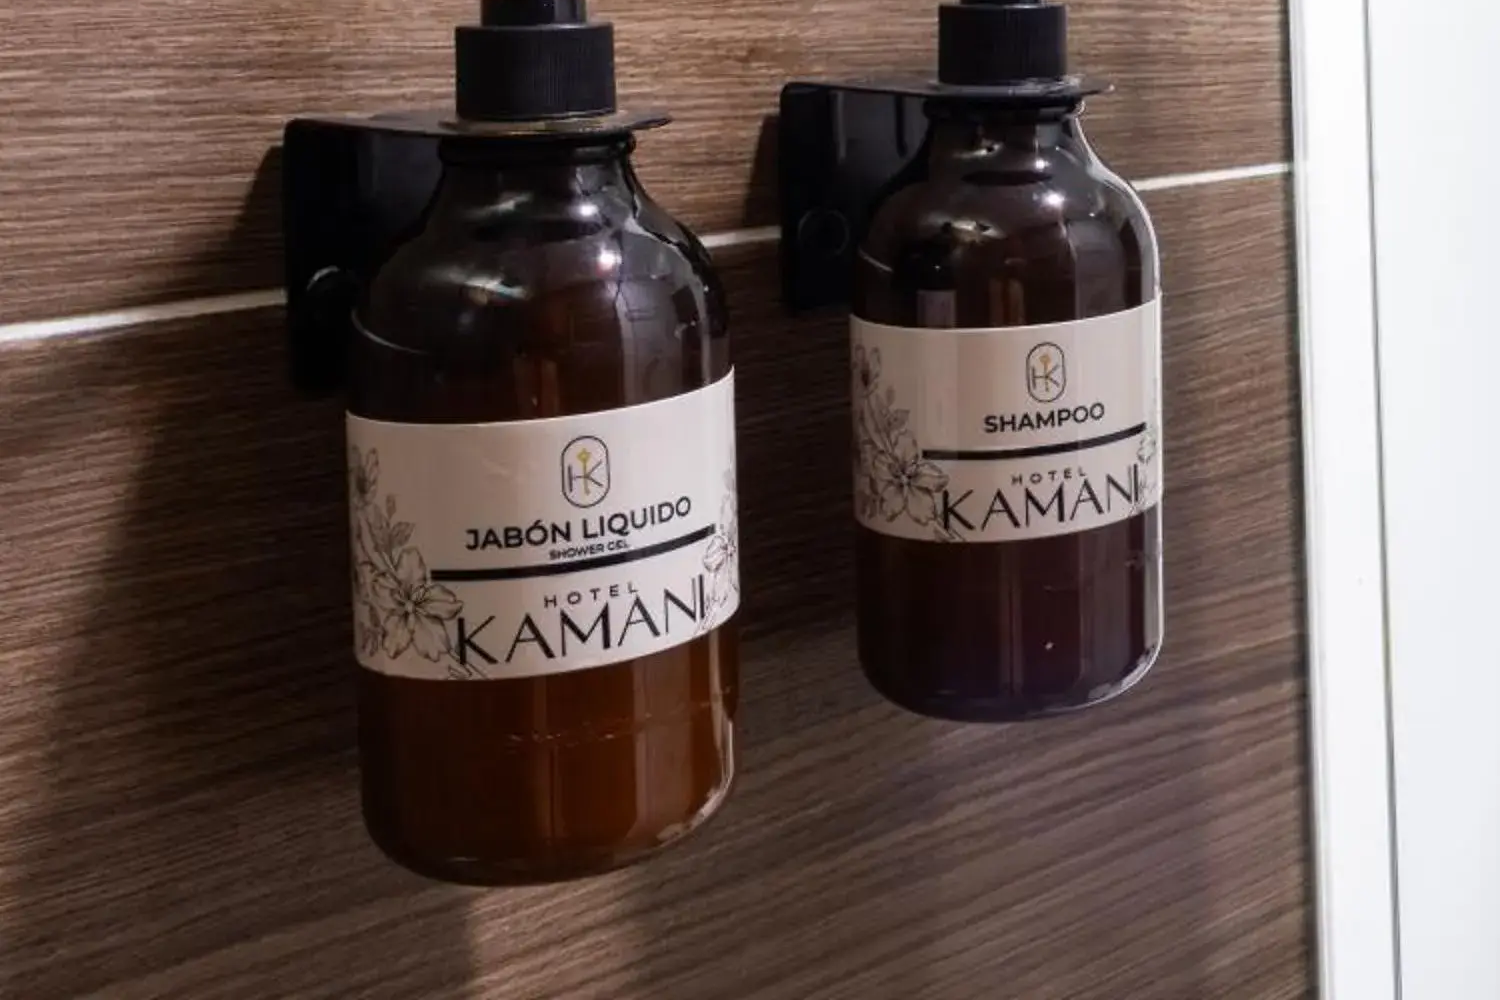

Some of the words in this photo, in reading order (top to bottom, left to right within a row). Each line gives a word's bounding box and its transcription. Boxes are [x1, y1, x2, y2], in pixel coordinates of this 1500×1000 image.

[983, 402, 1106, 434] SHAMPOO
[1011, 466, 1087, 486] HOTEL
[941, 463, 1139, 532] KAMANI
[465, 519, 572, 550] JABÓN
[581, 495, 692, 540] LIQUIDO
[548, 543, 605, 561] SHOWER
[543, 581, 640, 610] HOTEL
[456, 573, 705, 666] KAMANI
